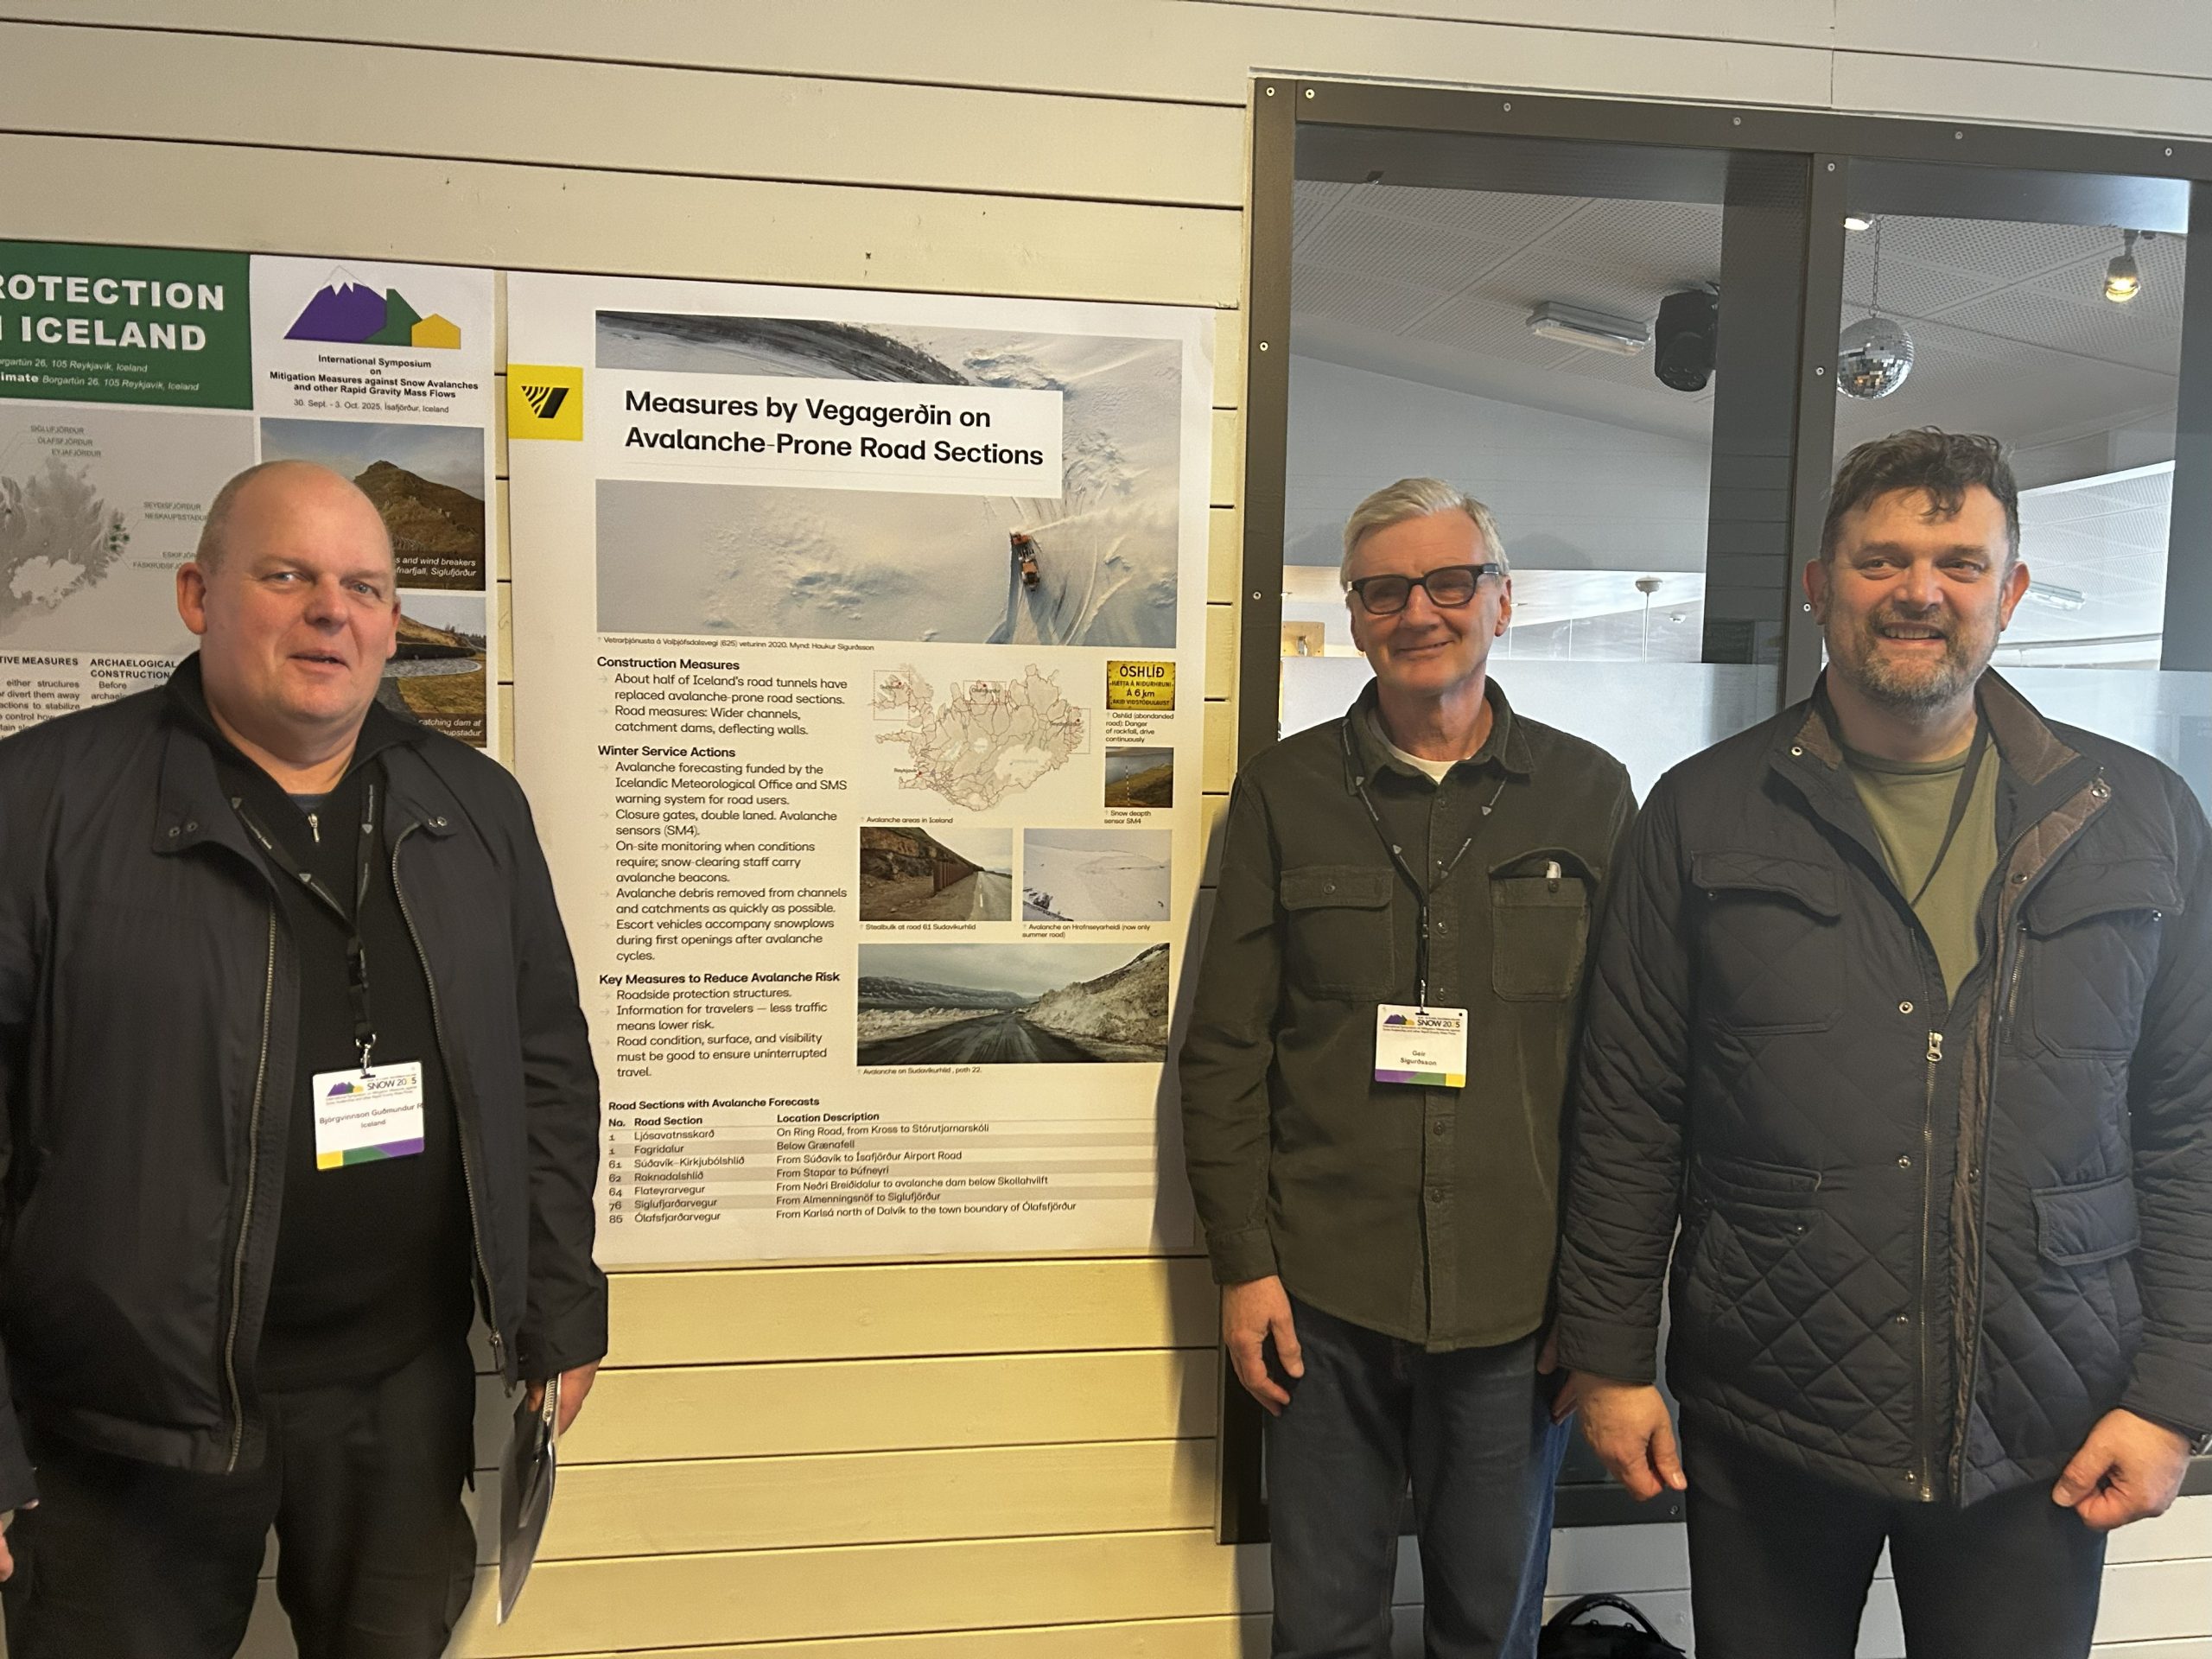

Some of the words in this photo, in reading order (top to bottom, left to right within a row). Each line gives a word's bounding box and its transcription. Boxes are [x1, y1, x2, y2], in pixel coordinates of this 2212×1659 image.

[0, 274, 224, 311] OTECTION
[22, 315, 206, 351] ICELAND
[318, 354, 376, 365] International
[378, 358, 431, 368] Symposium
[168, 382, 199, 391] Iceland
[270, 371, 315, 382] Mitigation
[318, 373, 362, 384] Measures
[365, 378, 397, 387] against
[400, 378, 425, 387] Snow
[427, 379, 479, 390] Avalanches
[313, 384, 338, 392] other
[340, 385, 366, 395] Rapid
[369, 385, 402, 397] Gravity
[404, 387, 427, 397] Mass
[429, 389, 456, 397] Flows
[626, 390, 758, 416] Measures
[766, 396, 798, 423] by
[805, 397, 951, 428] Vegagerðin
[959, 411, 990, 428] on
[625, 426, 852, 456] Avalanche-Prone
[861, 436, 925, 460] Road
[933, 440, 1043, 465] Sections
[441, 557, 476, 567] breakers
[22, 657, 78, 665] MEASURES
[597, 656, 677, 669] Construction
[679, 658, 740, 670] Measures
[6, 678, 31, 687] either
[37, 680, 79, 689] structures
[99, 681, 127, 690] Before
[614, 672, 650, 683] About
[652, 673, 676, 684] half
[677, 674, 690, 684] of
[747, 677, 772, 687] road
[776, 677, 817, 688] tunnels
[820, 678, 848, 689] have
[7, 690, 31, 698] divert
[33, 690, 55, 699] them
[56, 692, 80, 701] away
[614, 689, 664, 702] replaced
[668, 690, 764, 704] avalanche-prone
[766, 693, 792, 703] road
[795, 694, 845, 704] sections.
[1134, 688, 1141, 697] 6
[614, 705, 645, 715] Road
[648, 708, 708, 717] measures:
[709, 707, 744, 718] Wider
[747, 708, 801, 721] channels,
[614, 721, 677, 732] catchment
[680, 722, 715, 734] dams,
[718, 723, 774, 736] deflecting
[777, 724, 808, 734] walls.
[597, 745, 639, 756] Winter
[641, 746, 687, 757] Service
[690, 747, 735, 757] Actions
[614, 761, 676, 772] Avalanche
[677, 761, 743, 775] forecasting
[745, 763, 785, 774] funded
[788, 764, 803, 776] by
[804, 764, 823, 774] the
[615, 777, 668, 788] Icelandic
[671, 778, 756, 791] Meteorological
[758, 779, 793, 790] Office
[795, 779, 817, 790] and
[819, 779, 848, 790] SMS
[614, 793, 661, 806] warning
[664, 794, 706, 806] system
[708, 794, 724, 804] for
[727, 794, 753, 804] road
[599, 974, 623, 987] Key
[626, 974, 685, 984] Measures
[688, 974, 701, 983] to
[703, 973, 748, 983] Reduce
[751, 971, 812, 982] Avalanche
[815, 971, 840, 982] Risk
[616, 989, 670, 1000] Roadside
[672, 988, 730, 1001] protection
[733, 988, 791, 998] structures.
[367, 1080, 395, 1090] SNOW
[608, 1101, 636, 1110] Road
[639, 1100, 684, 1109] Sections
[687, 1099, 709, 1108] with
[711, 1098, 766, 1108] Avalanche
[768, 1097, 819, 1106] Forecasts
[360, 1119, 386, 1128] Iceland
[608, 1118, 626, 1127] No.
[634, 1116, 661, 1126] Road
[663, 1116, 702, 1125] Section
[777, 1113, 821, 1122] Location
[823, 1112, 880, 1123] Description
[776, 1128, 791, 1137] On
[793, 1127, 815, 1138] Ring
[817, 1126, 844, 1136] Road,
[847, 1126, 868, 1135] from
[871, 1125, 898, 1134] Kross
[634, 1144, 684, 1156] Fagridalur
[777, 1141, 805, 1150] Below
[776, 1154, 801, 1164] From
[843, 1154, 854, 1162] to
[903, 1151, 935, 1161] Airport
[938, 1150, 962, 1160] Road
[608, 1160, 622, 1169] 61
[608, 1173, 621, 1183] 62
[608, 1187, 622, 1198] 64
[634, 1186, 705, 1196] Flateyrarvegur
[608, 1200, 622, 1211] 76
[634, 1198, 717, 1211] Siglufjarðarvegur
